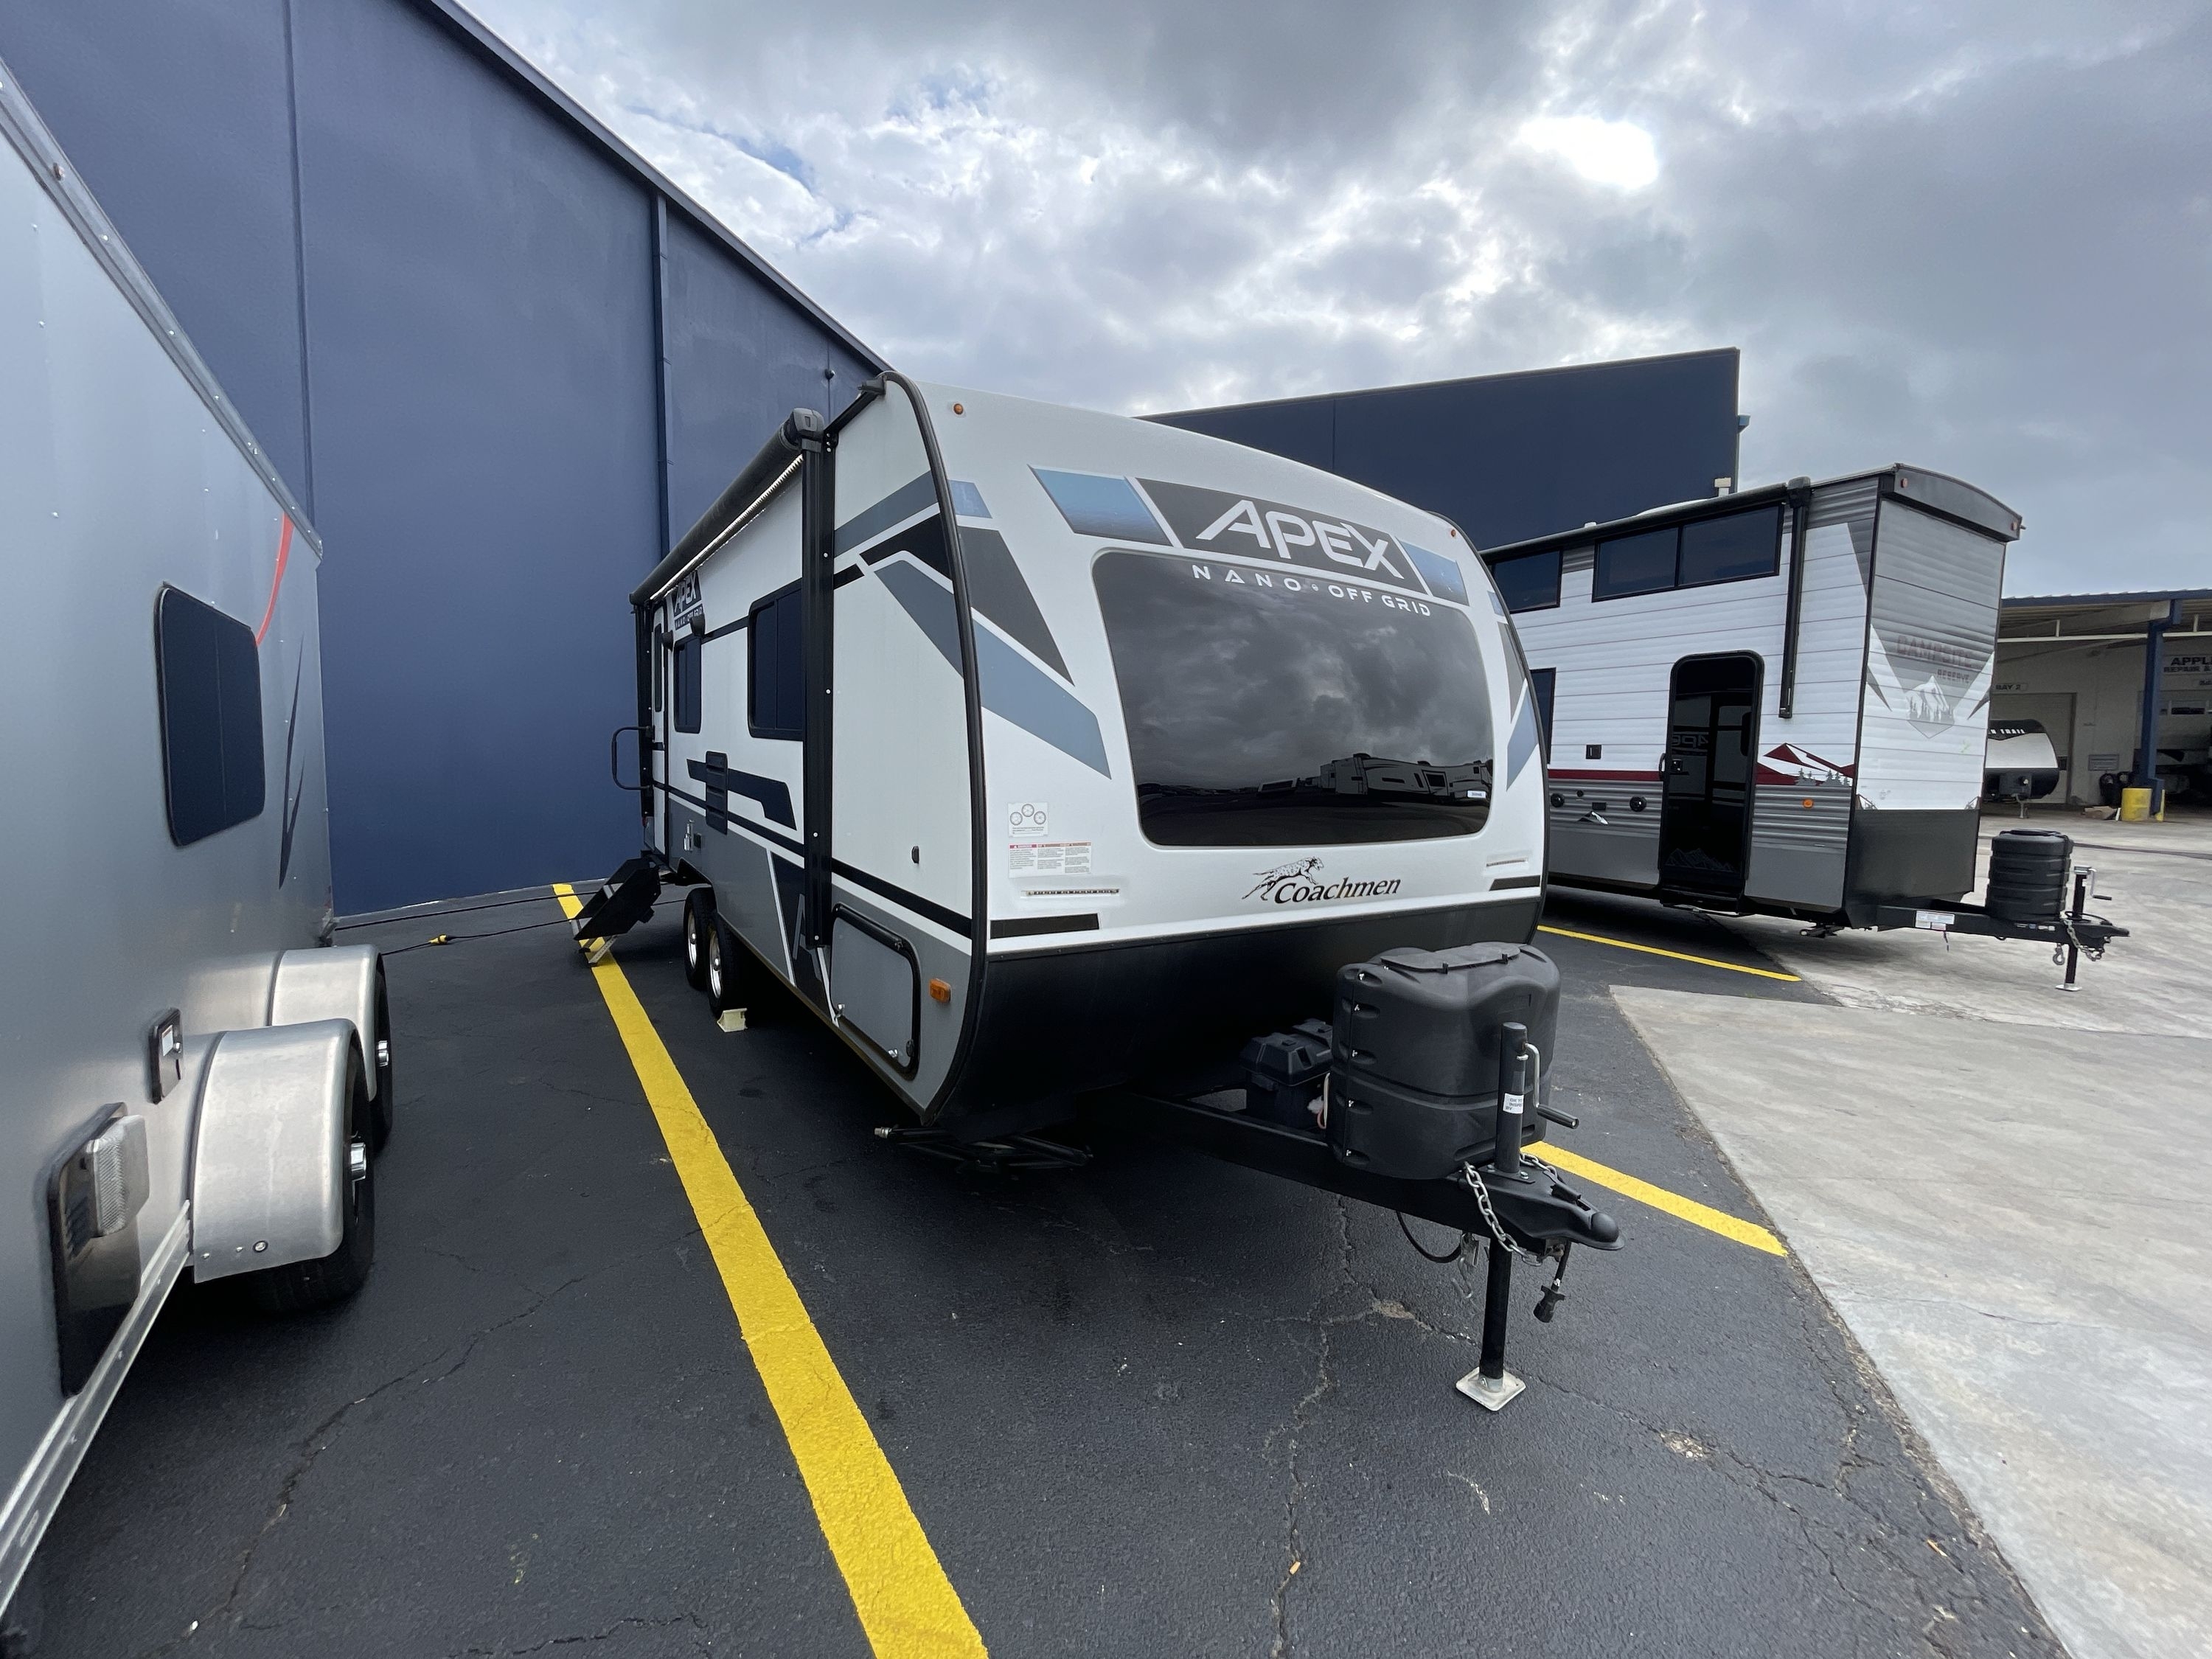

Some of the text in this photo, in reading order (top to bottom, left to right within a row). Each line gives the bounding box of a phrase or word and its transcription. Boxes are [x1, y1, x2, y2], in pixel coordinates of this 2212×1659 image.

[1195, 499, 1405, 580] APEX
[1192, 564, 1431, 616] NANO OFF GRID
[1937, 669, 1969, 684] RESERVE
[1274, 877, 1401, 904] Coachmen
